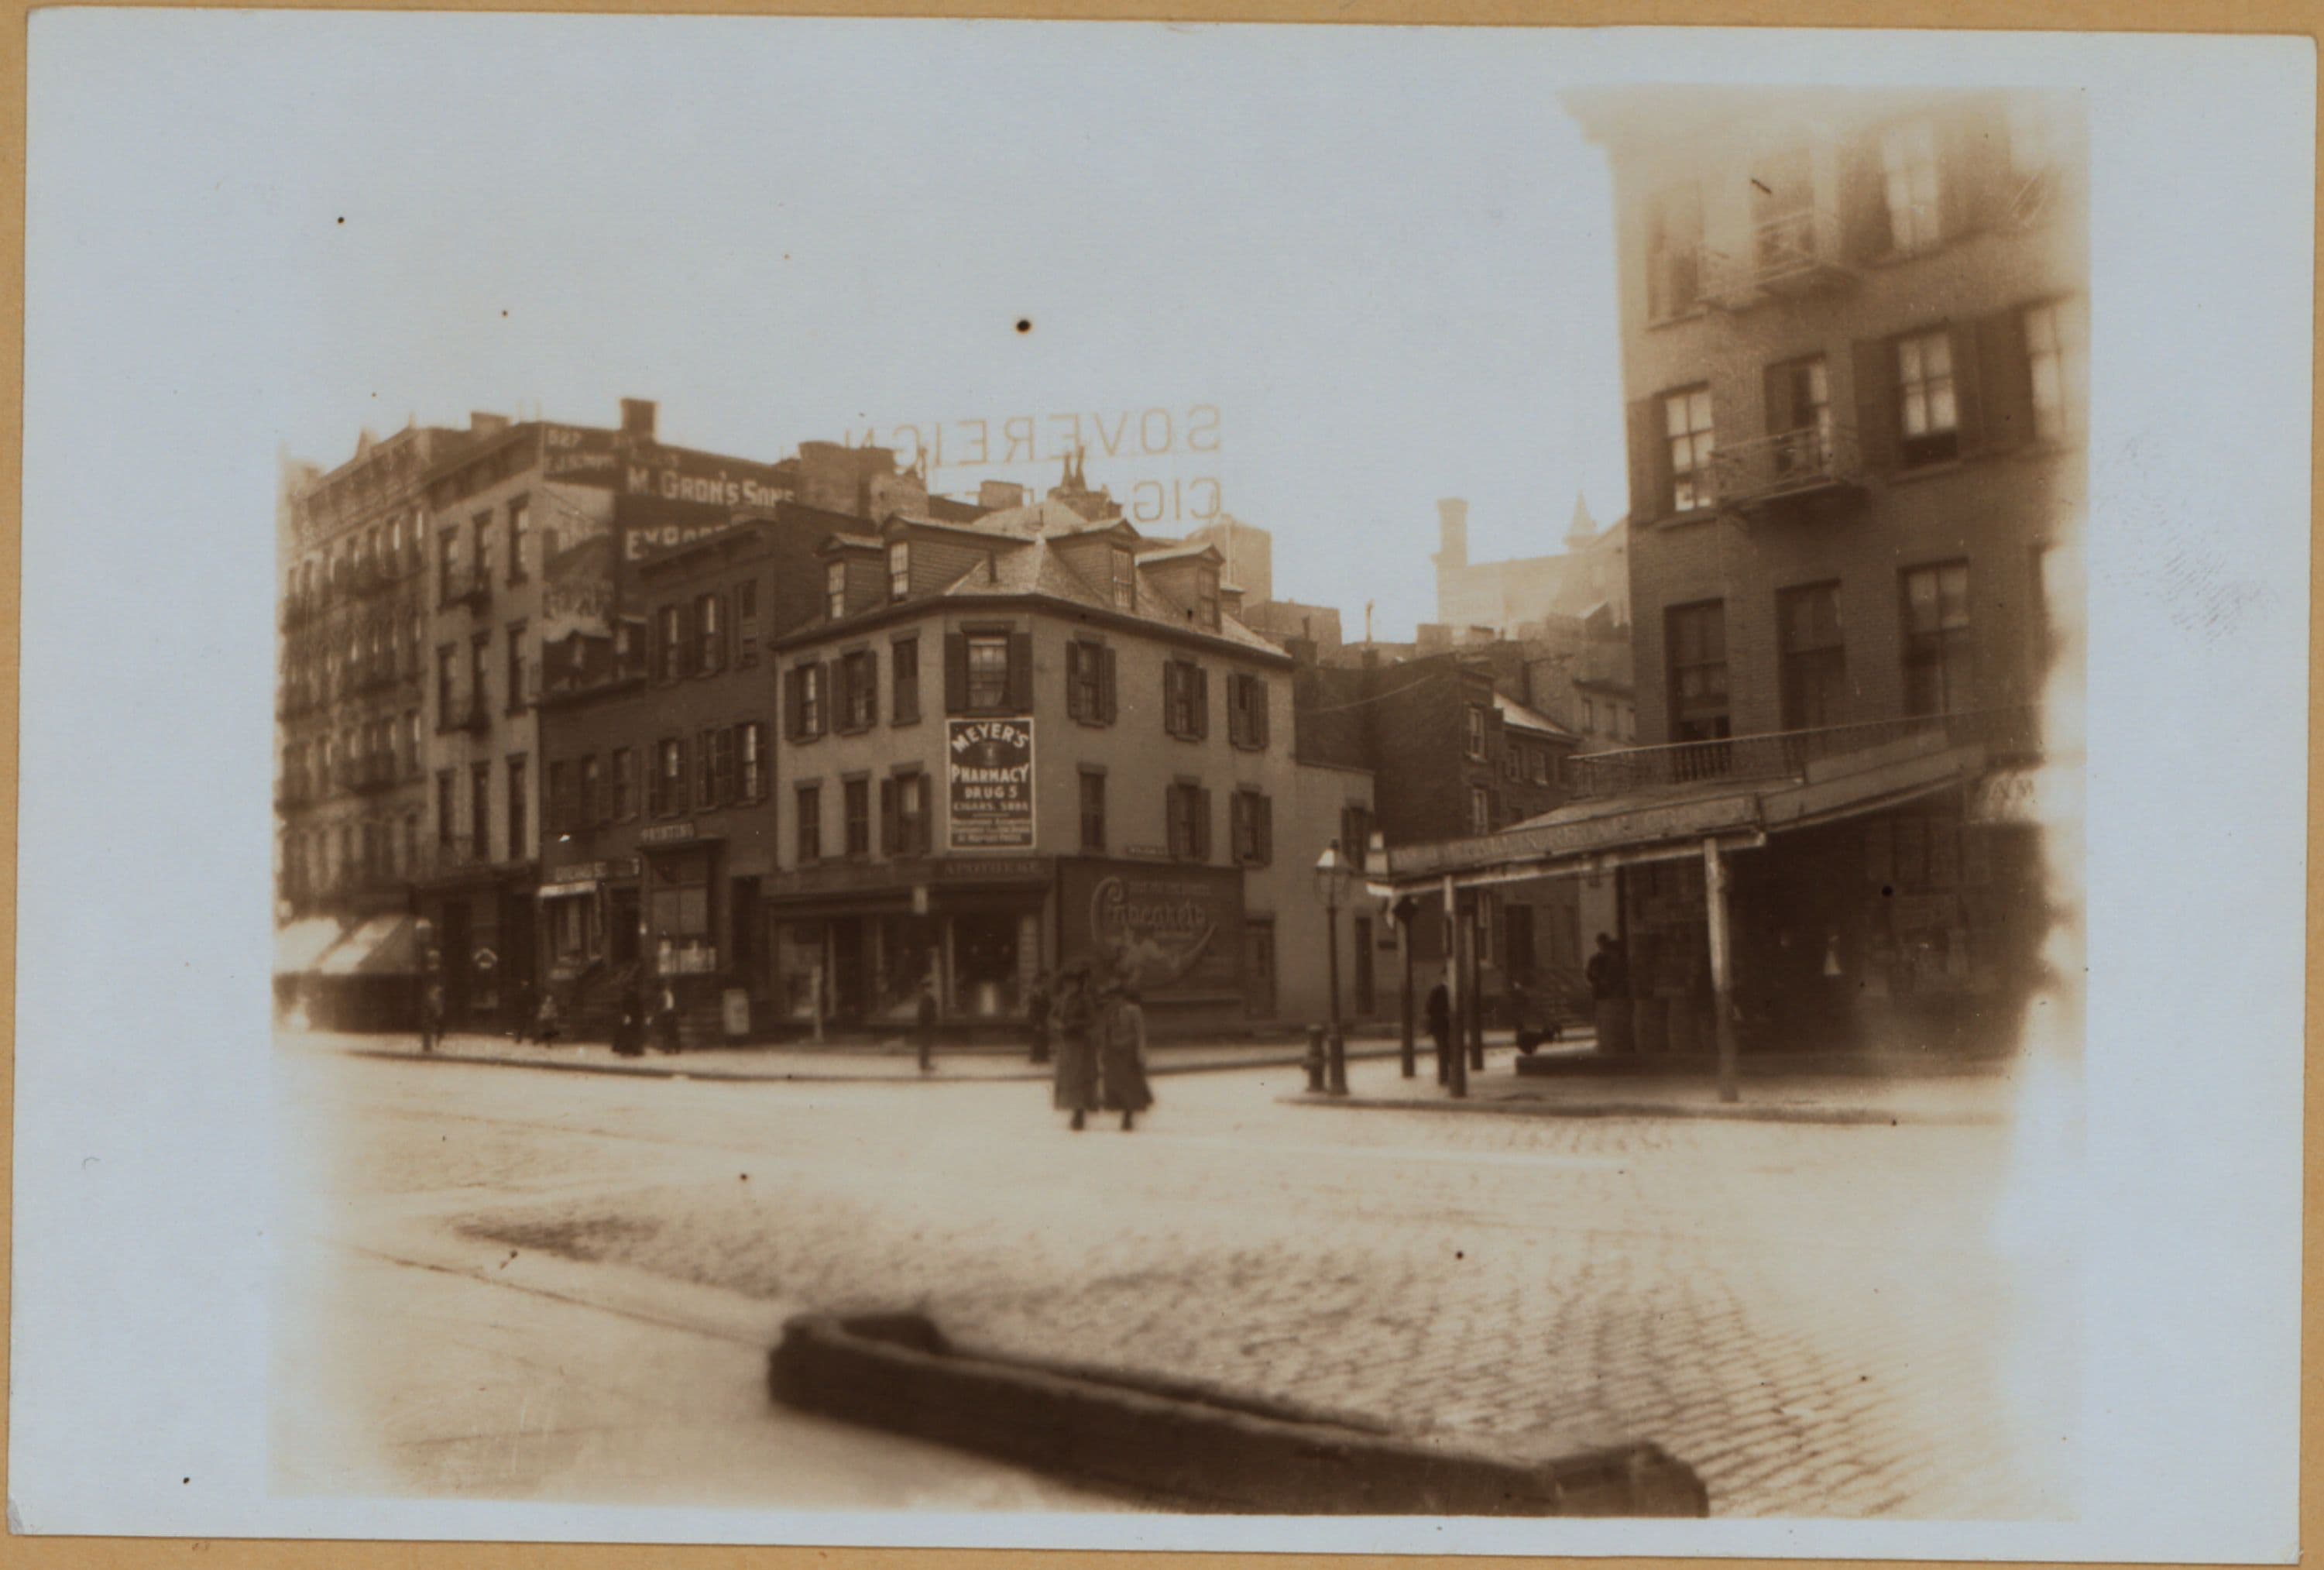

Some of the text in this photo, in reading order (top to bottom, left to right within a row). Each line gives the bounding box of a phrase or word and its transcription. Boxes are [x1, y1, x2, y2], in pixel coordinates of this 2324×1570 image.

[951, 723, 1030, 754] MEYER'S
[951, 762, 1030, 783] PHARMACY
[965, 785, 1018, 799] DRUGS
